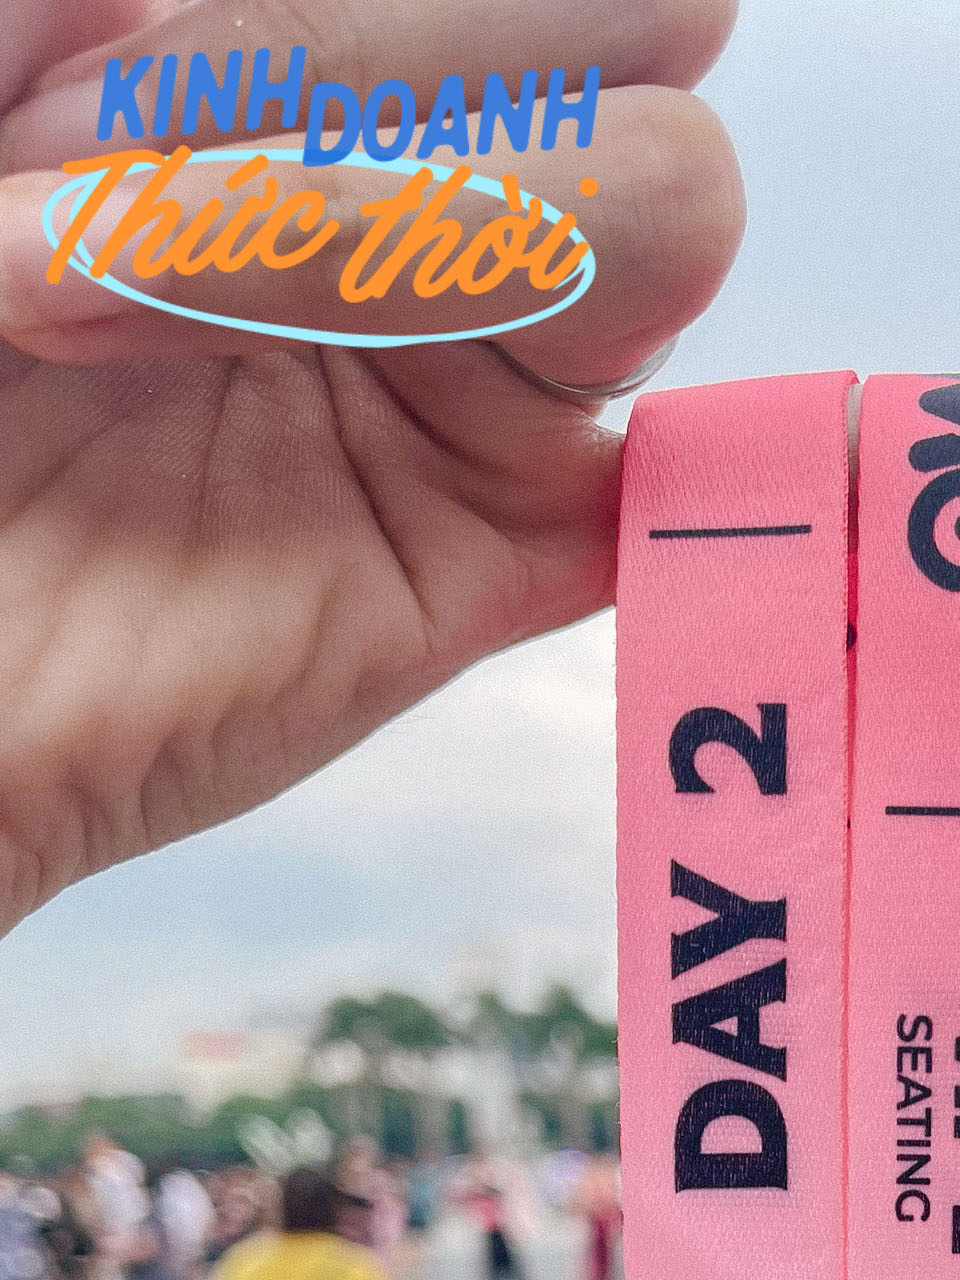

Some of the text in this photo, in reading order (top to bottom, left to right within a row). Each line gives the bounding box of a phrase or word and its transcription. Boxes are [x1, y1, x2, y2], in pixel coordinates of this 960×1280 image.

[668, 703, 789, 1194] DAY 2
[894, 1013, 933, 1222] SEATING
